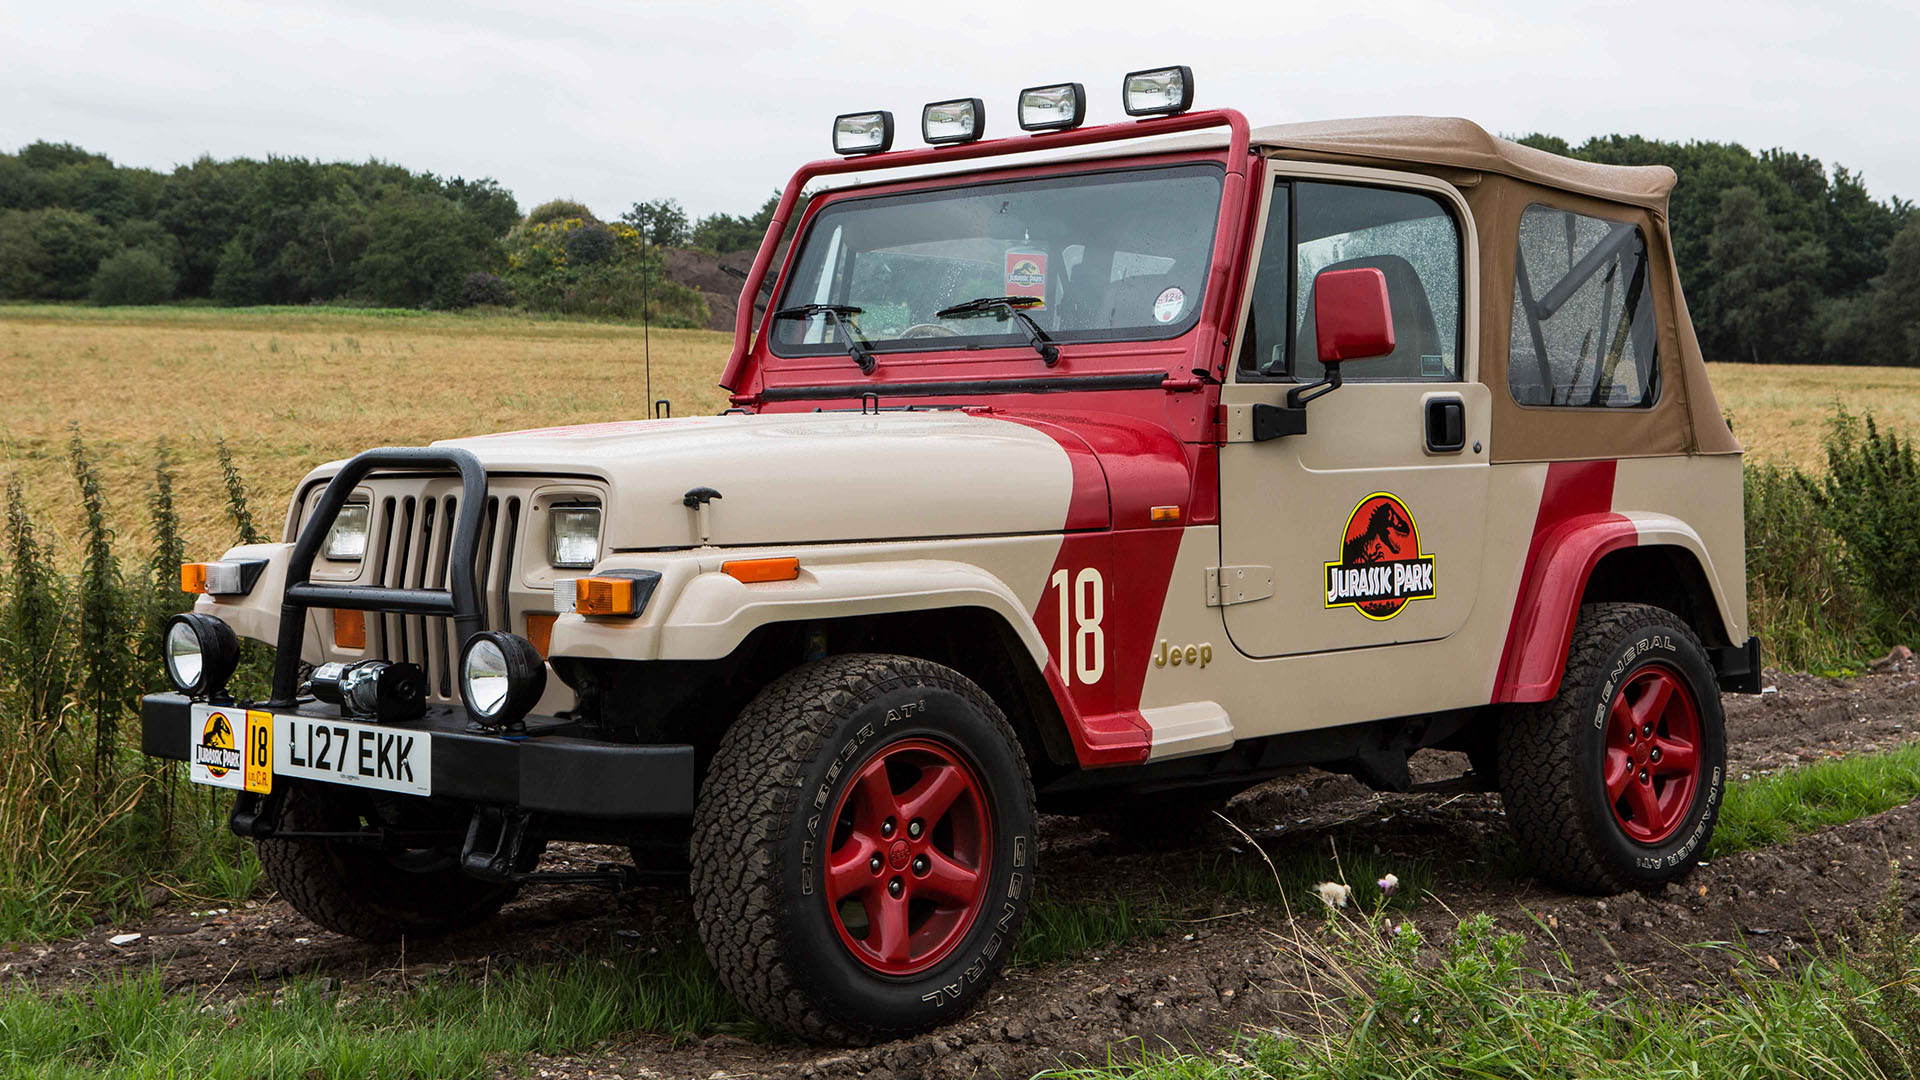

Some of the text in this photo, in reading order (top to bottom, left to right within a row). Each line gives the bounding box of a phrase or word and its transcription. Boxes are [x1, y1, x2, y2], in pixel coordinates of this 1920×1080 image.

[1327, 563, 1433, 603] JURASSIC PARK
[1051, 567, 1104, 687] 18
[1153, 638, 1213, 669] Jeep
[1594, 635, 1676, 730] GENERAL
[196, 745, 240, 768] JURASSIC PARK
[251, 725, 268, 768] 18
[290, 722, 414, 783] L127 EKK
[801, 722, 876, 895] GRABBER
[1667, 766, 1721, 867] GRABBER
[921, 836, 1026, 1008] GENERAL
